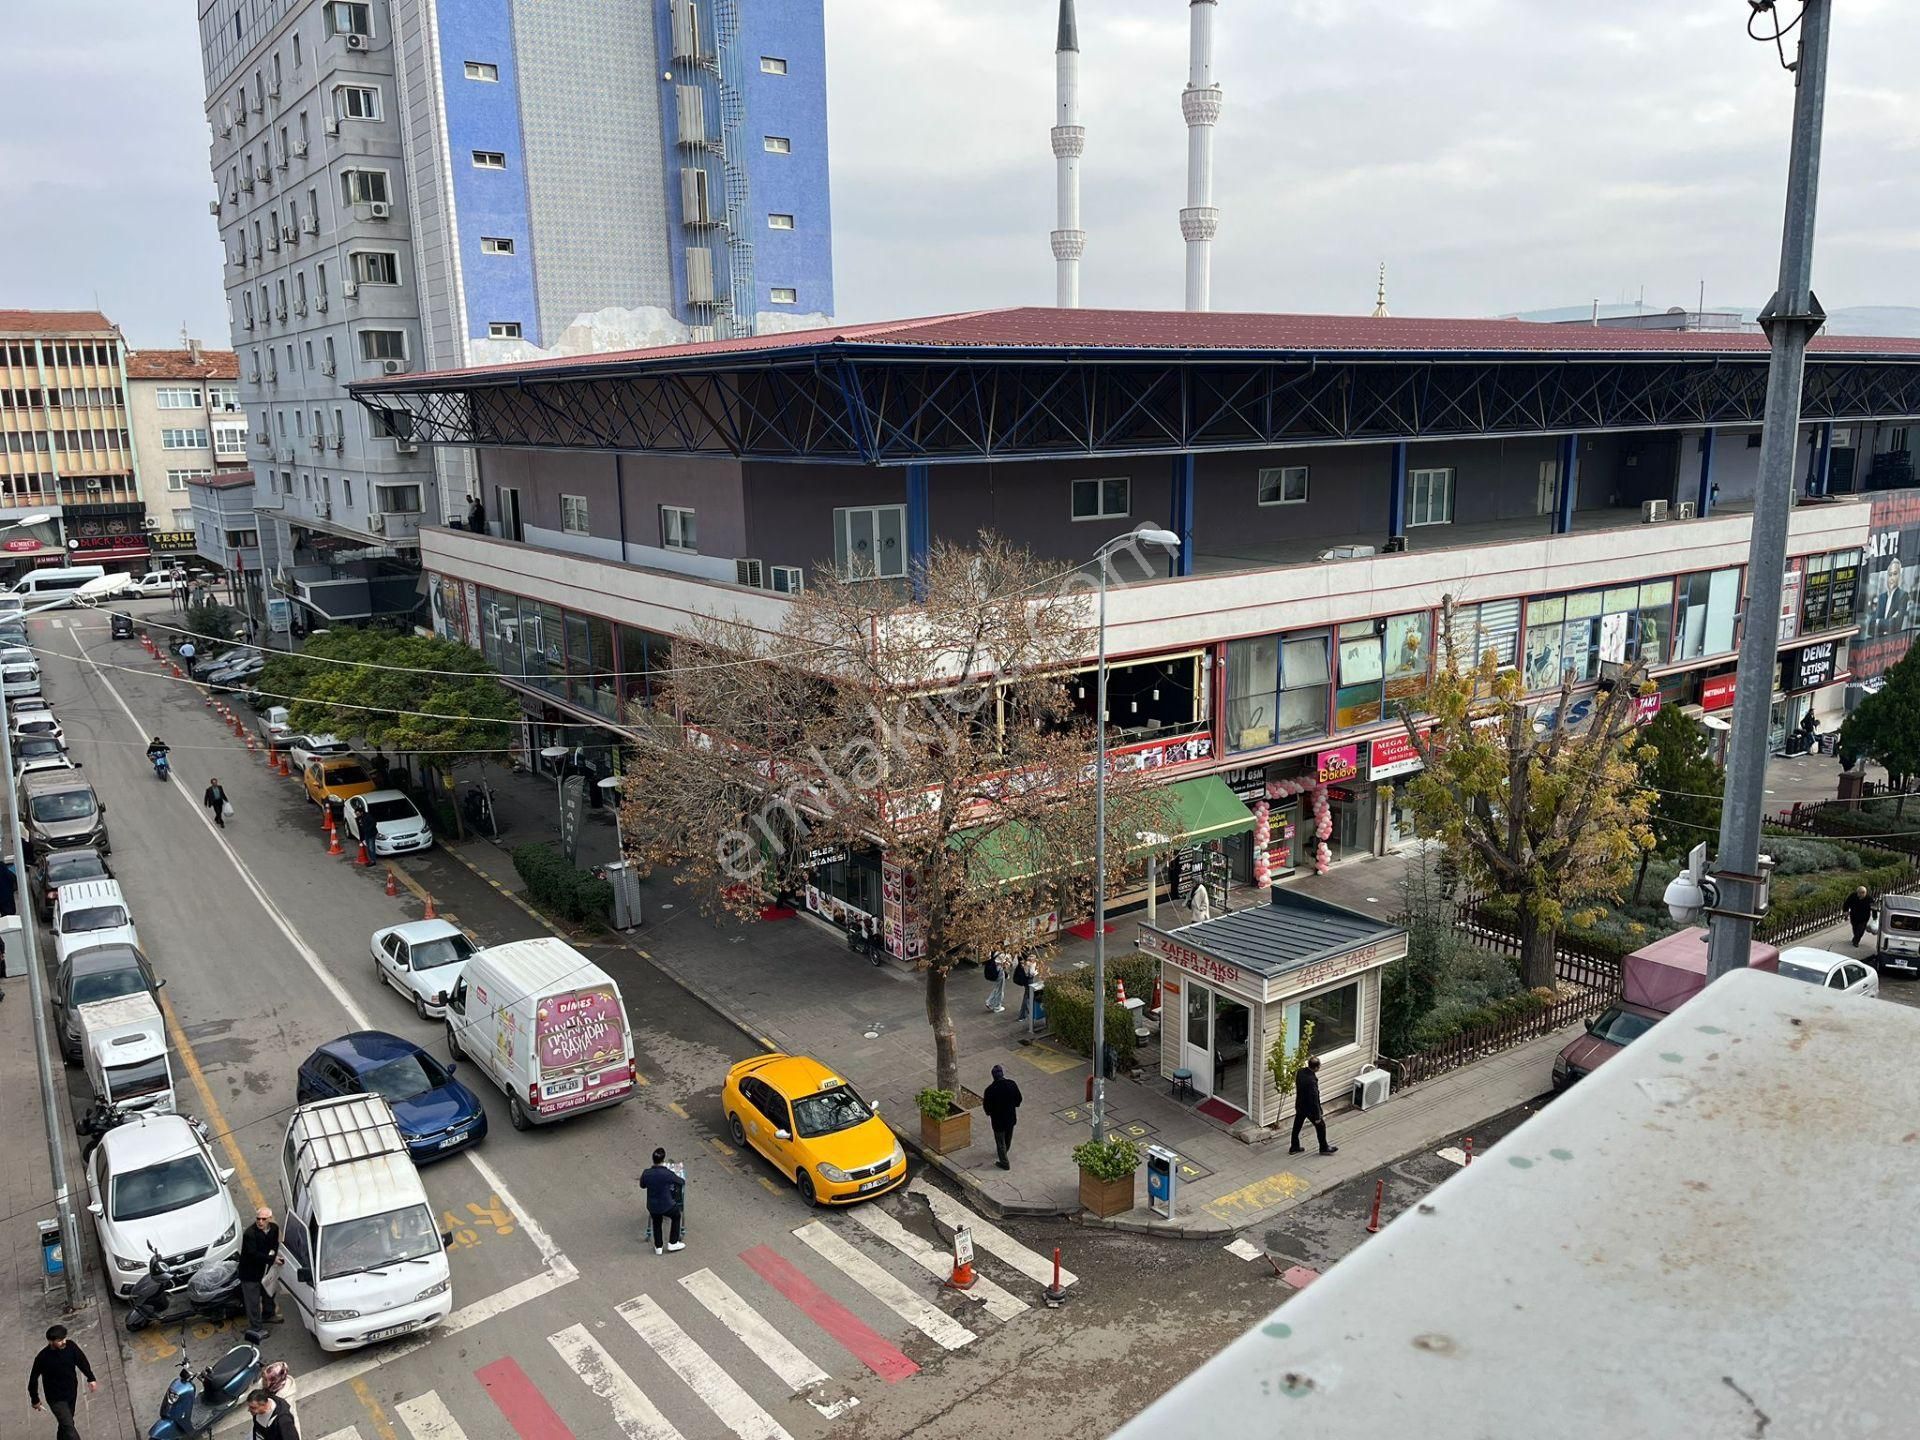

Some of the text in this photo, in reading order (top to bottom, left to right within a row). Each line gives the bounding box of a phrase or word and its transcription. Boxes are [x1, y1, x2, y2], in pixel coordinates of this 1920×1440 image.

[153, 533, 194, 543] YEŞİL
[1802, 643, 1832, 662] DENİZ
[1800, 661, 1829, 677] İLETİŞİM
[1378, 740, 1402, 749] MEGA
[1382, 745, 1411, 755] SİGOR
[1247, 769, 1264, 780] GSM
[1319, 767, 1358, 783] Baklava
[1161, 940, 1198, 964] ZAFER
[1296, 961, 1334, 985] ZAFER
